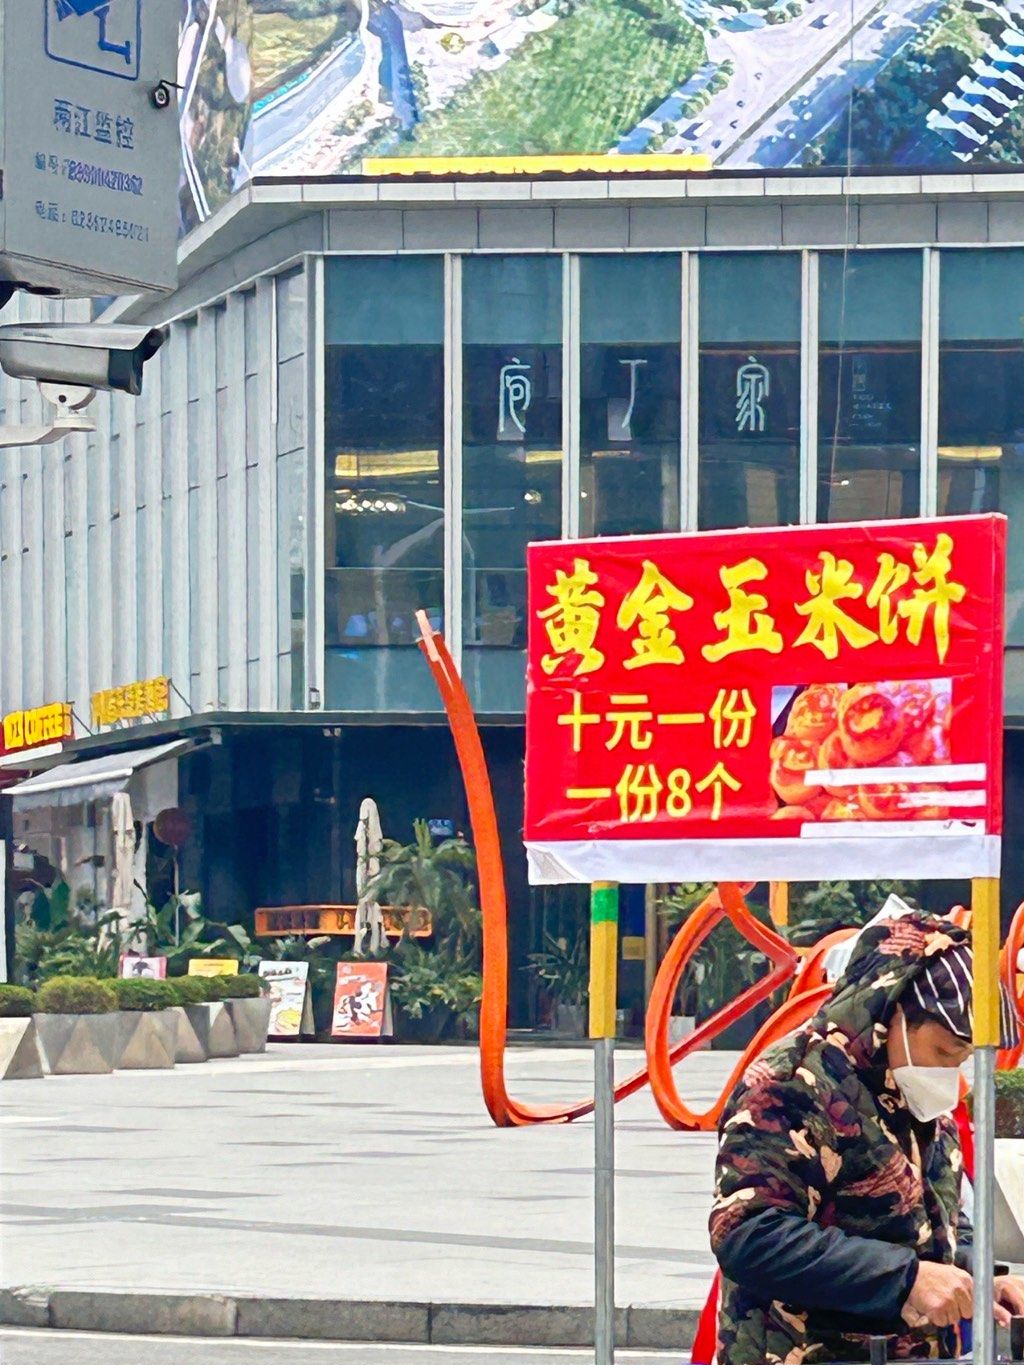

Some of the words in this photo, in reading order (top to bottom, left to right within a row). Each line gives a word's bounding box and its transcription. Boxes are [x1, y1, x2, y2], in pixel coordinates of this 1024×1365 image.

[537, 532, 966, 675] 黄金玉米饼
[557, 688, 757, 752] 十元一份
[566, 762, 742, 824] 一份8个
